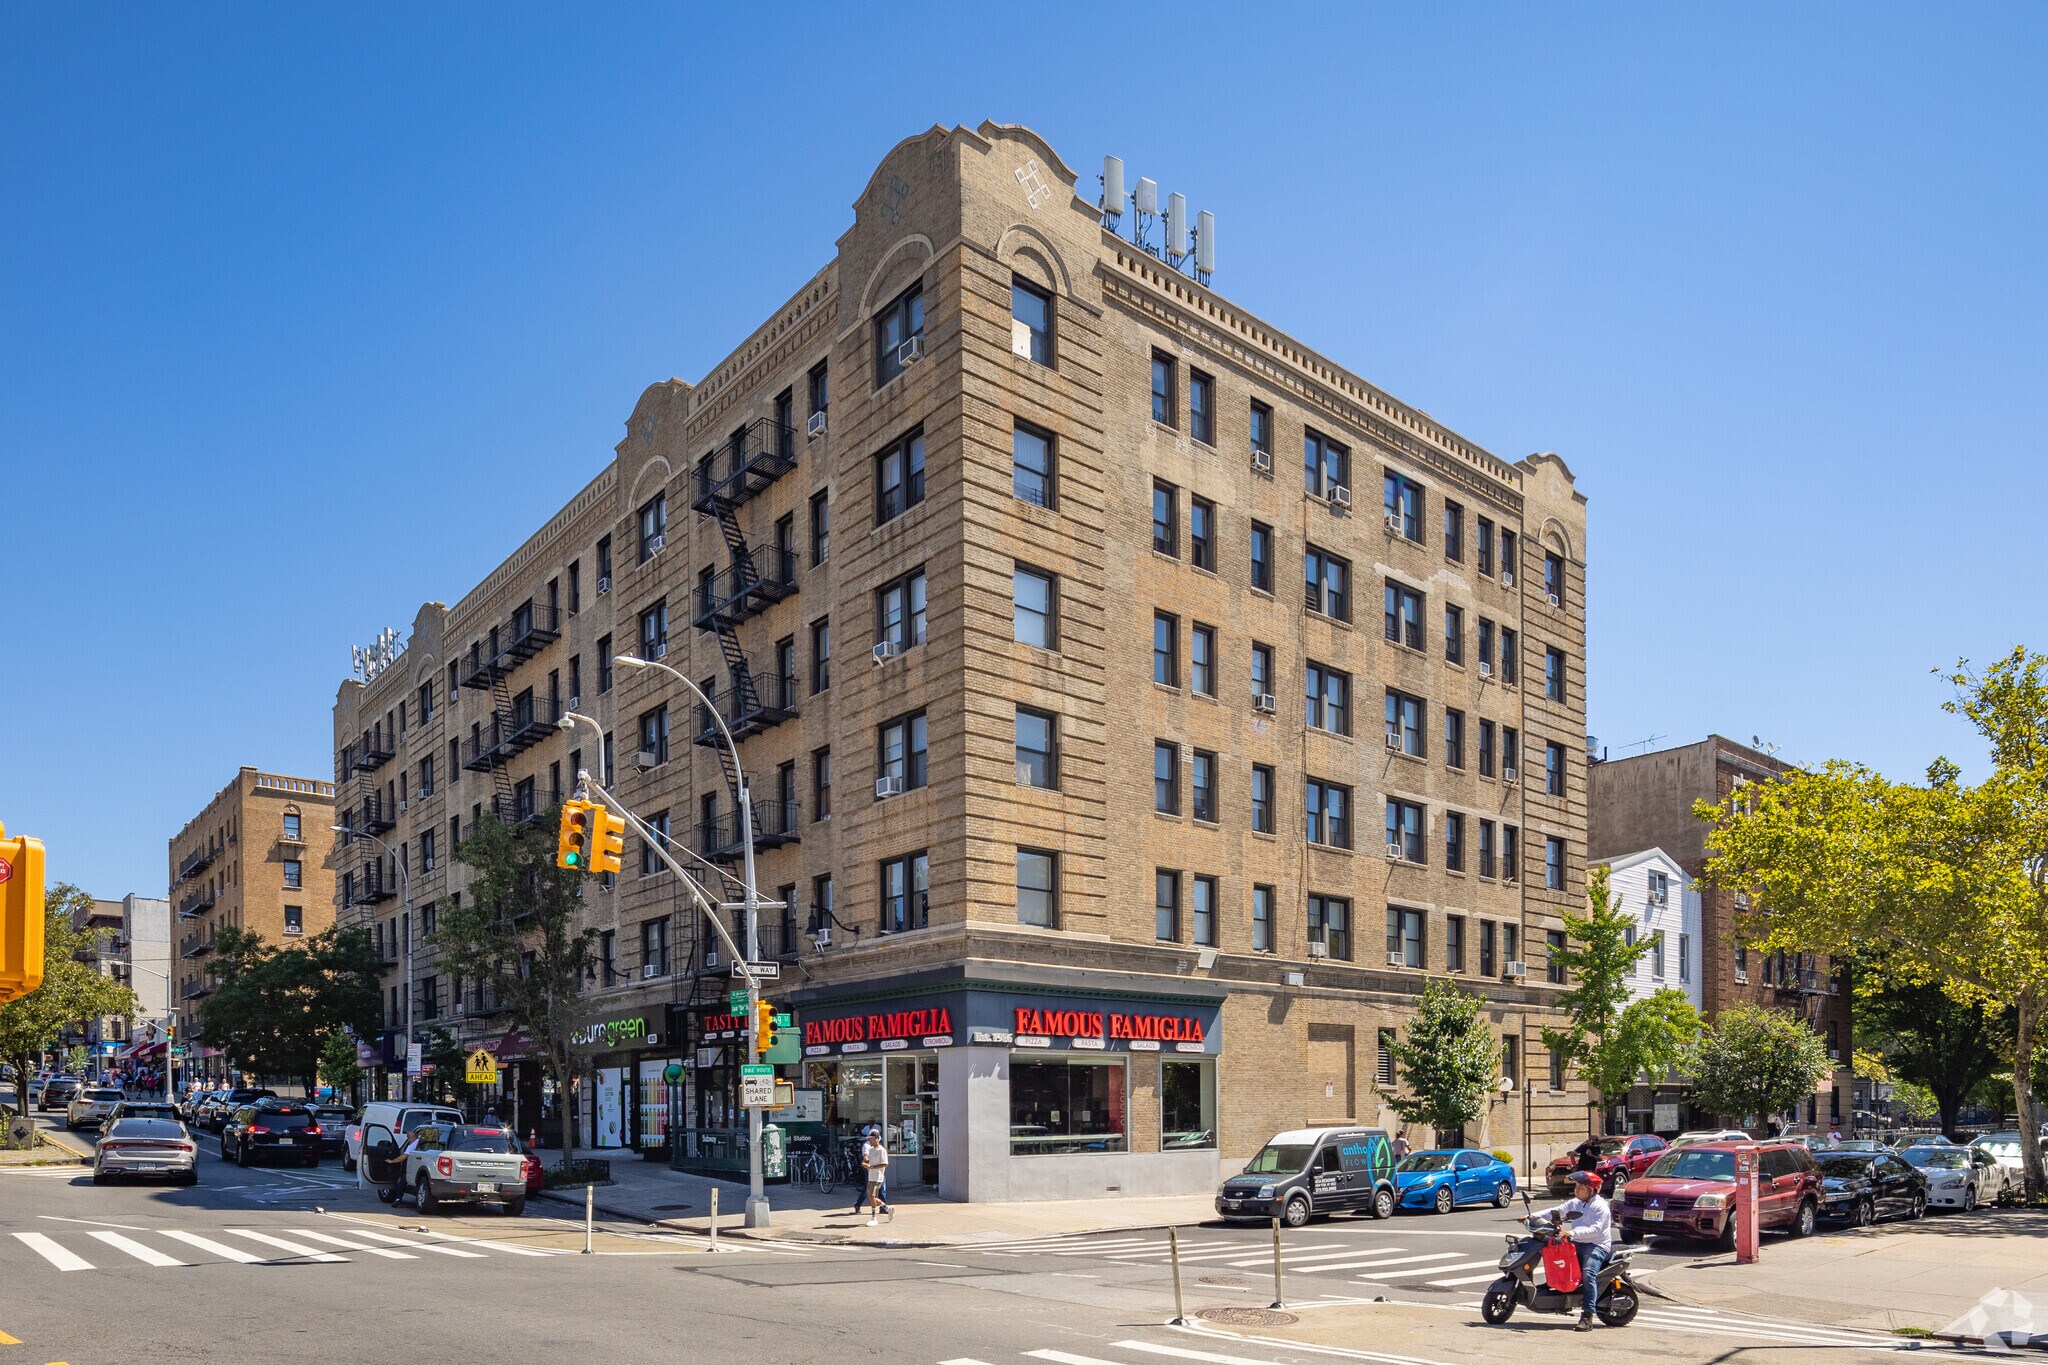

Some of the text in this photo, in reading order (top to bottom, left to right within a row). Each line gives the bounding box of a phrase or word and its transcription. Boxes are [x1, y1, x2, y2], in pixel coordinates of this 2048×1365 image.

[704, 1014, 740, 1031] TASTY
[805, 1008, 953, 1045] FAMOUS FAMIGLIA
[1015, 1008, 1205, 1042] FAMOUS FAMIGLIA
[924, 1037, 949, 1046] STROMBOLI
[1136, 1041, 1156, 1049] SALADS
